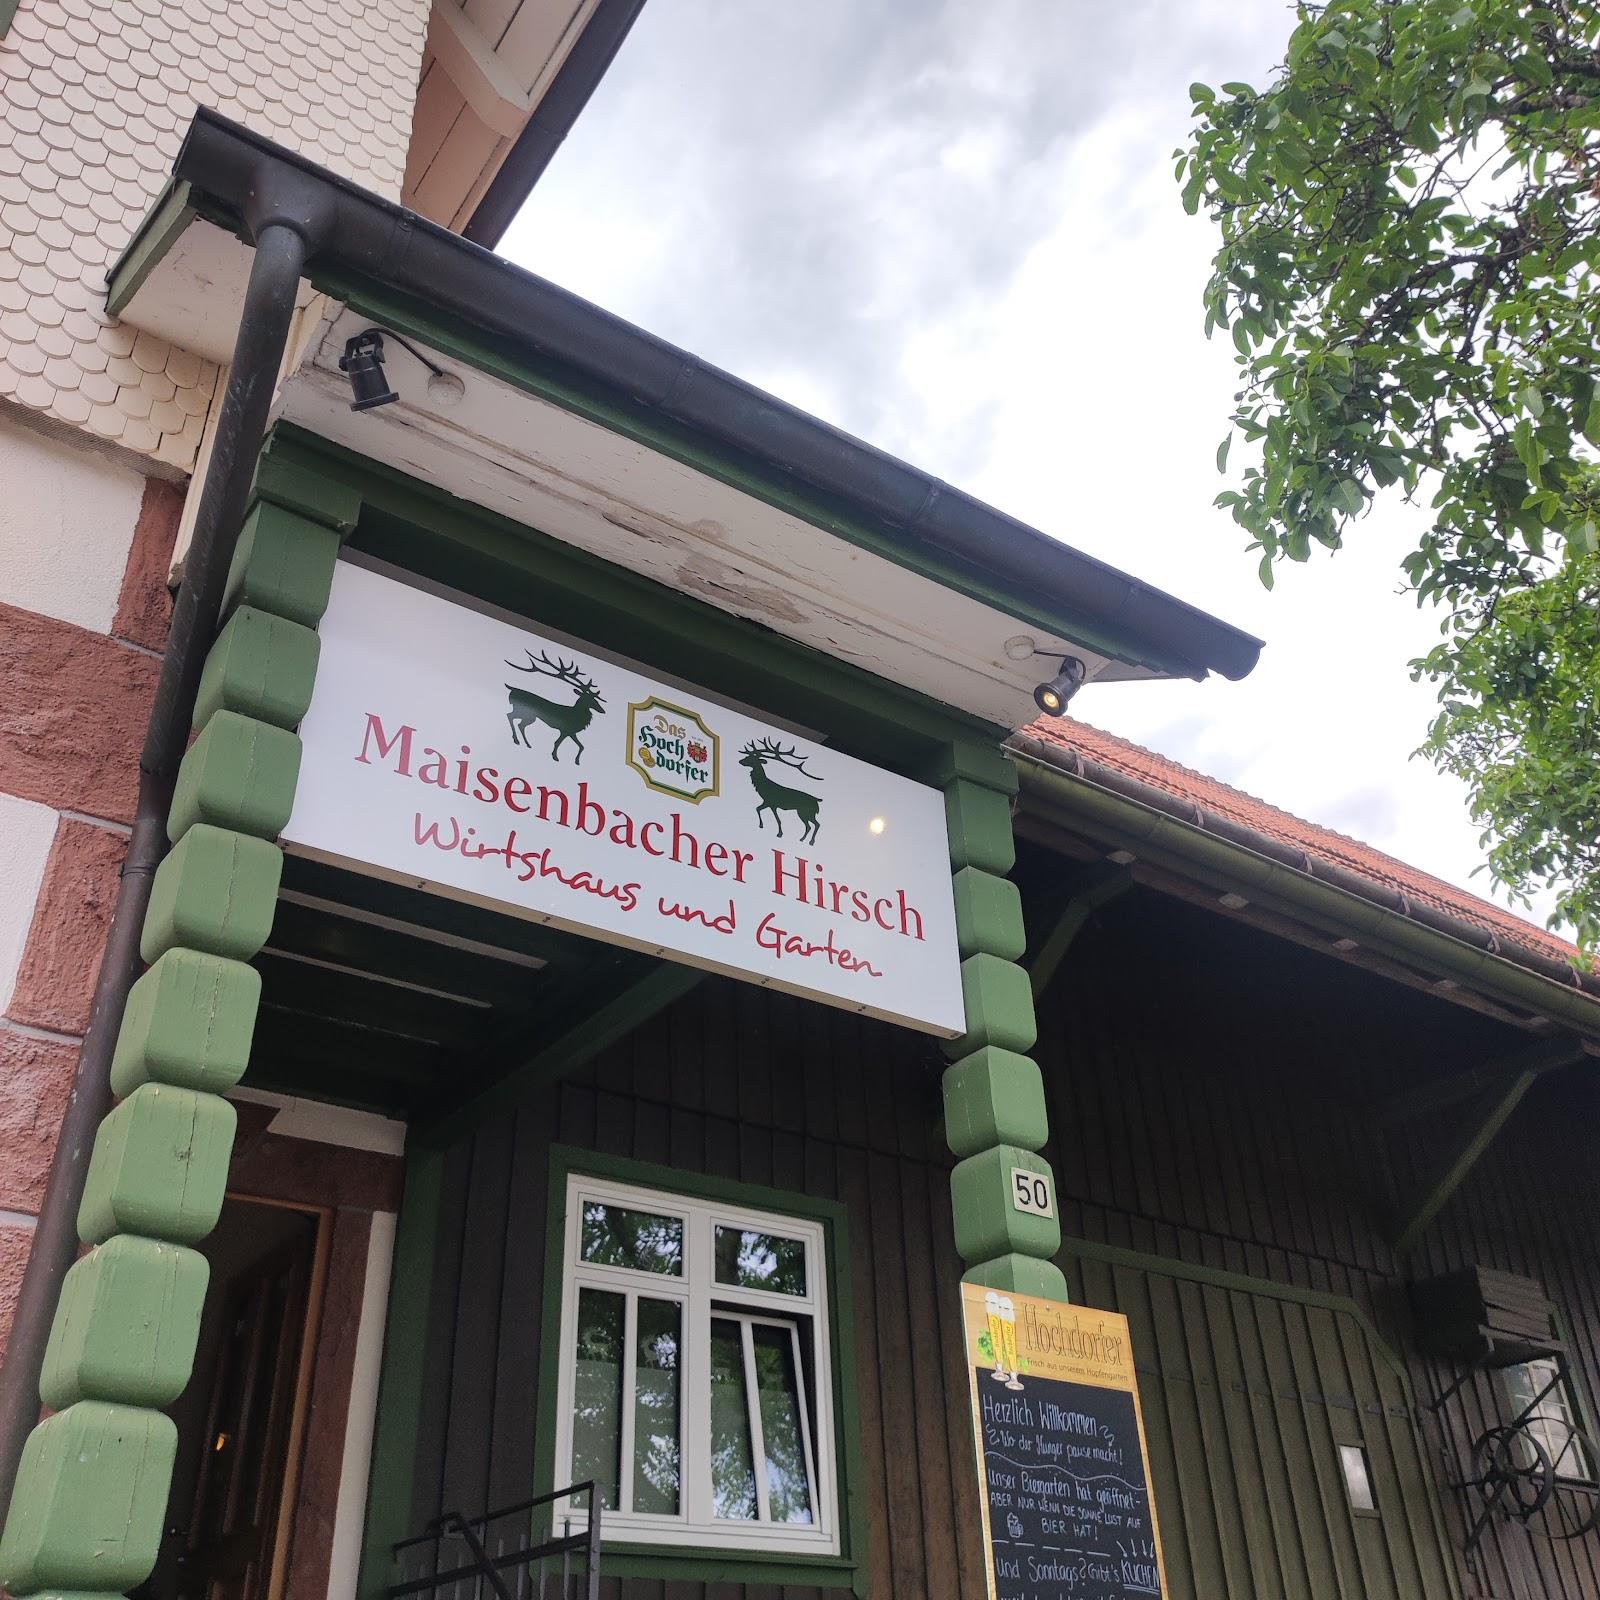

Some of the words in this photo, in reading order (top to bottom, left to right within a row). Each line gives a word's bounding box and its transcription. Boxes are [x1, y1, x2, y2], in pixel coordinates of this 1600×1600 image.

[638, 725, 684, 761] Hoch
[654, 714, 687, 740] Das
[656, 749, 709, 783] dorfer
[354, 712, 754, 884] Maisenbacher
[771, 848, 926, 941] Hirsch
[414, 812, 642, 912] Wirtshaus
[658, 897, 736, 935] und
[755, 912, 883, 978] Garten
[1015, 1173, 1048, 1209] 50
[1023, 1302, 1123, 1366] Hochdorfer
[1027, 1357, 1045, 1368] Frisch
[983, 1393, 1034, 1427] Herzlich
[1039, 1400, 1098, 1438] Willkommen
[988, 1468, 1016, 1489] Unser
[1021, 1471, 1070, 1501] Biergarten
[1075, 1480, 1092, 1501] hat
[990, 1491, 1013, 1507] ABER
[1018, 1496, 1036, 1510] NUR
[1038, 1500, 1061, 1514] WENN
[1063, 1504, 1076, 1517] DIE
[1078, 1507, 1103, 1523] SONNE
[1104, 1513, 1122, 1526] LUST
[1126, 1516, 1142, 1529] AUF
[1041, 1517, 1067, 1534] BIER
[996, 1557, 1020, 1579] Und
[1121, 1559, 1160, 1588] KUCHEN
